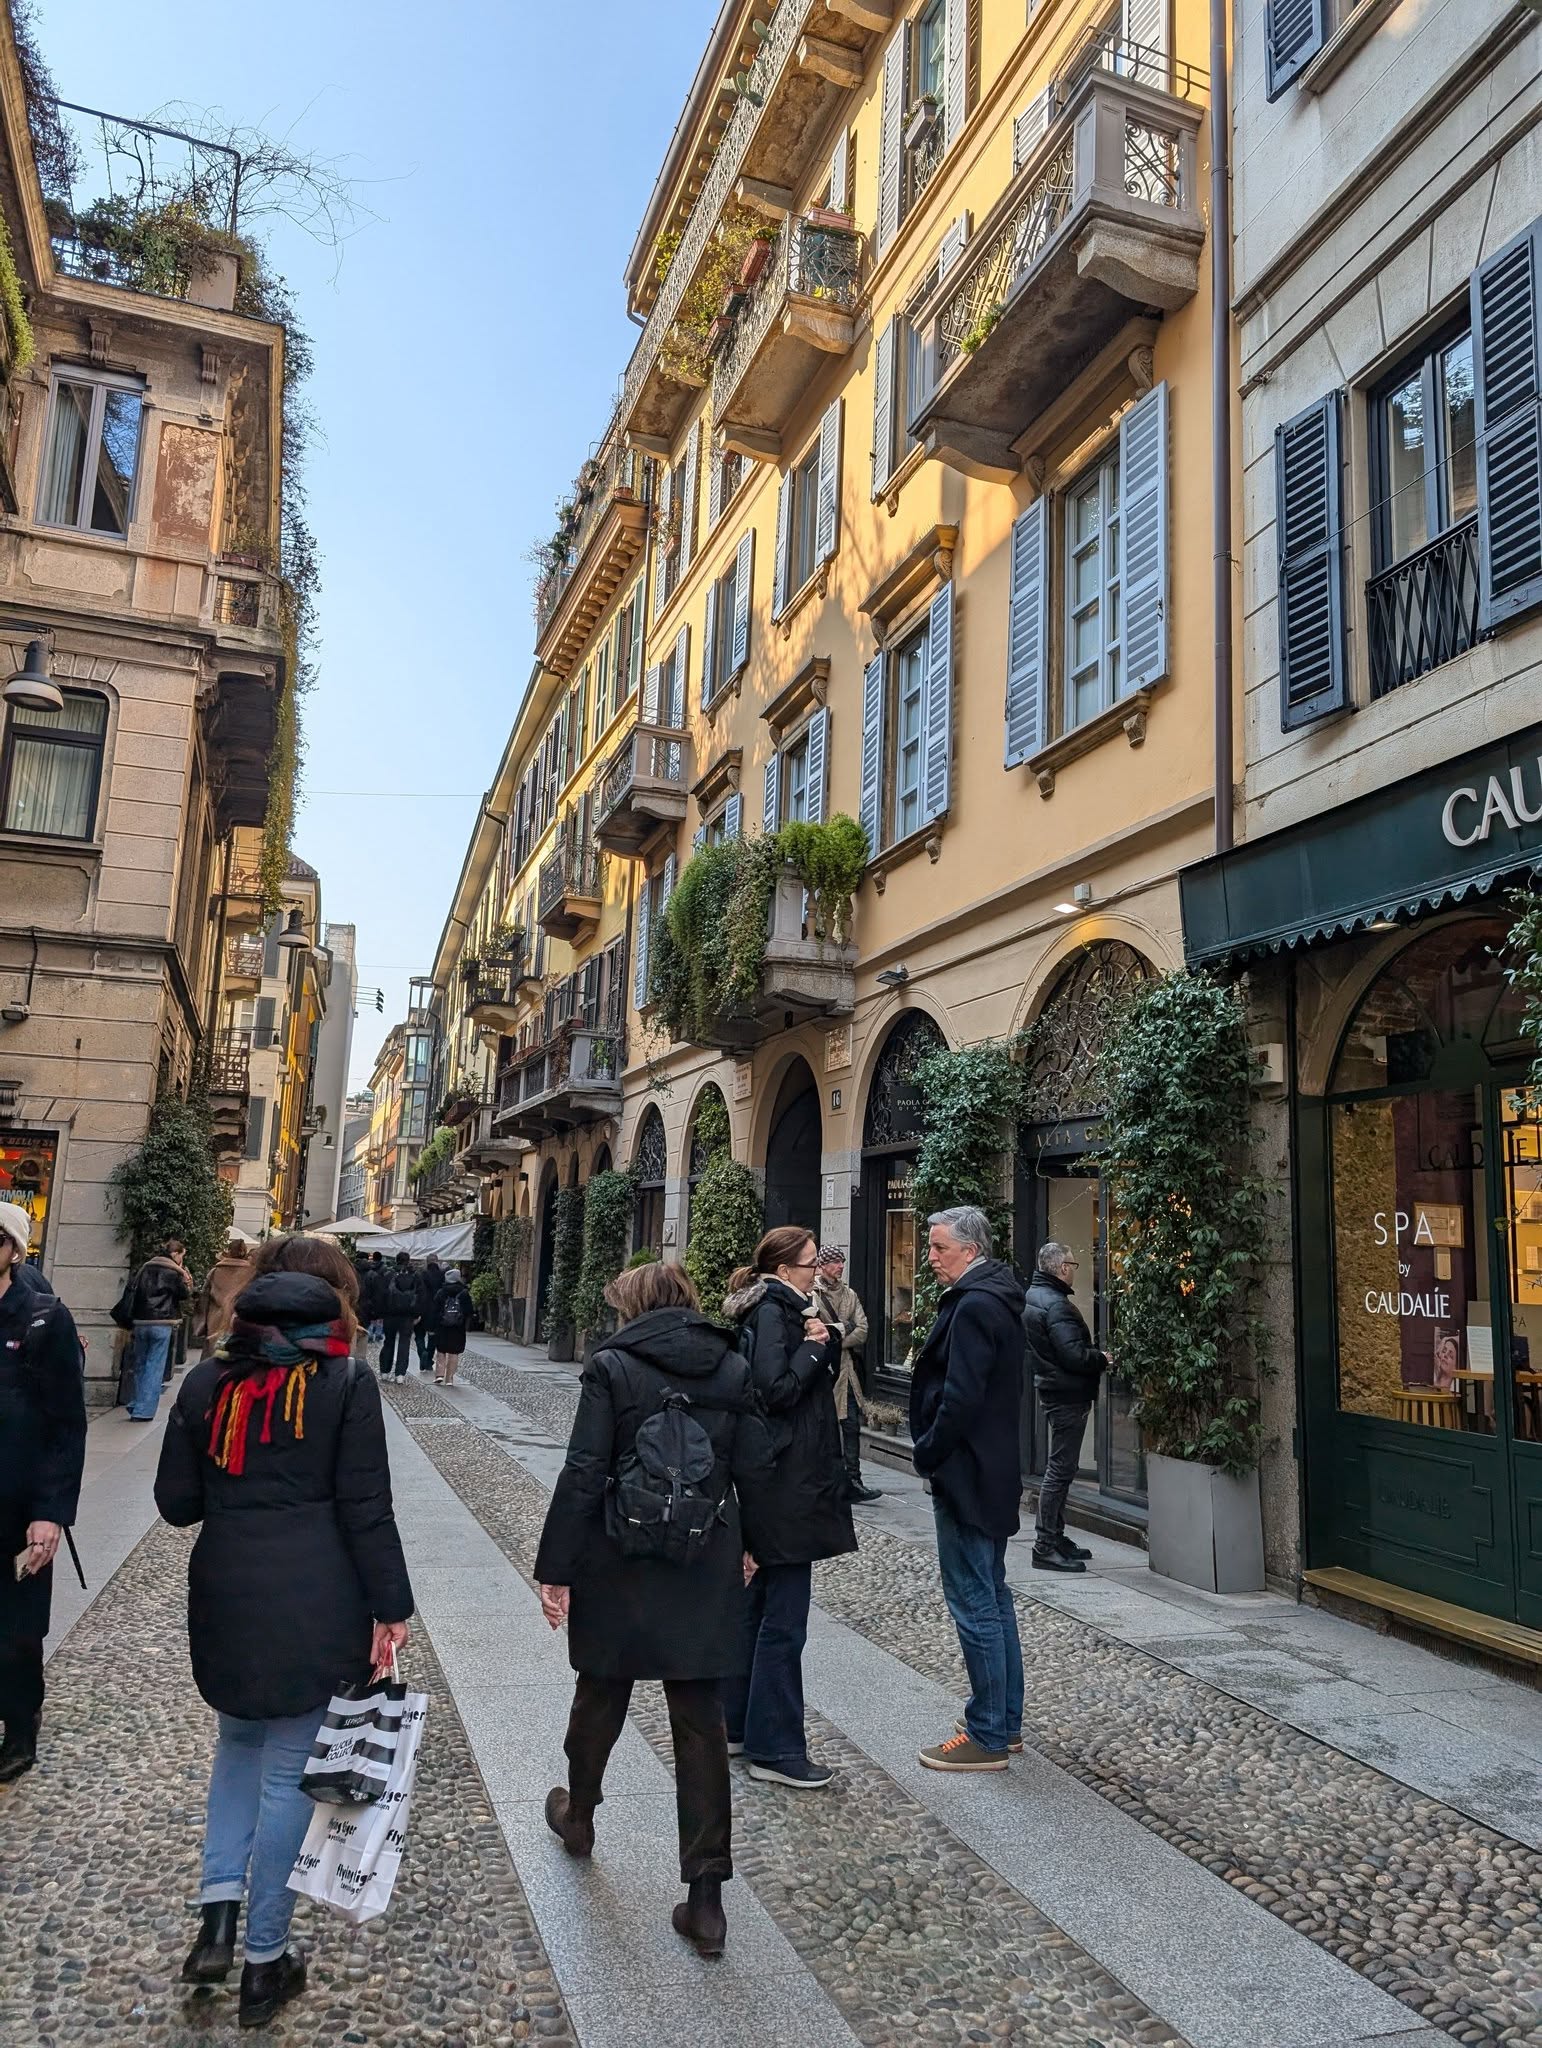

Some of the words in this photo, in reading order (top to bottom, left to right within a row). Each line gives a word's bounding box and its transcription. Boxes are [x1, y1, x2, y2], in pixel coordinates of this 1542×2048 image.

[833, 1091, 841, 1107] 16
[1374, 1211, 1434, 1245] SPA
[1398, 1260, 1411, 1277] by
